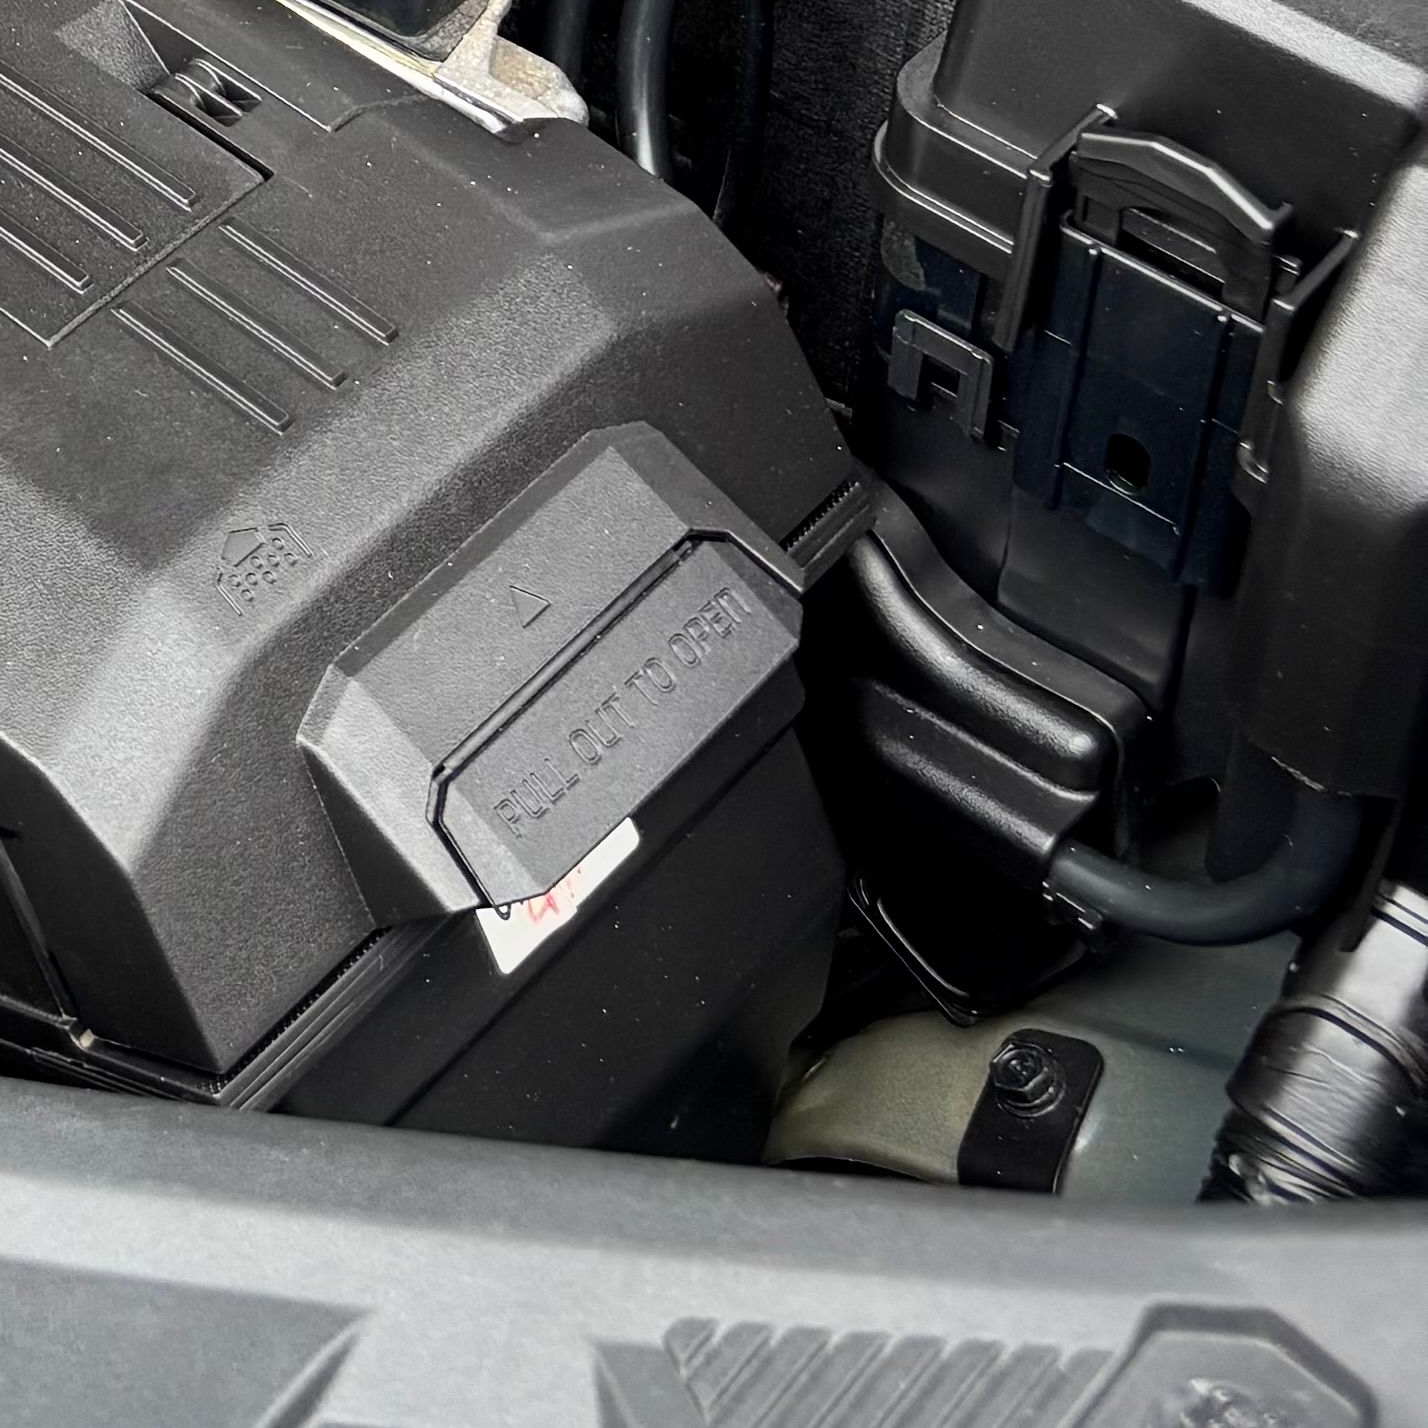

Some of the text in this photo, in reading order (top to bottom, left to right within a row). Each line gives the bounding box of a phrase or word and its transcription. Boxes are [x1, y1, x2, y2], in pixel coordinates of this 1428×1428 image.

[493, 586, 752, 838] PULL OUT TO OPEN
